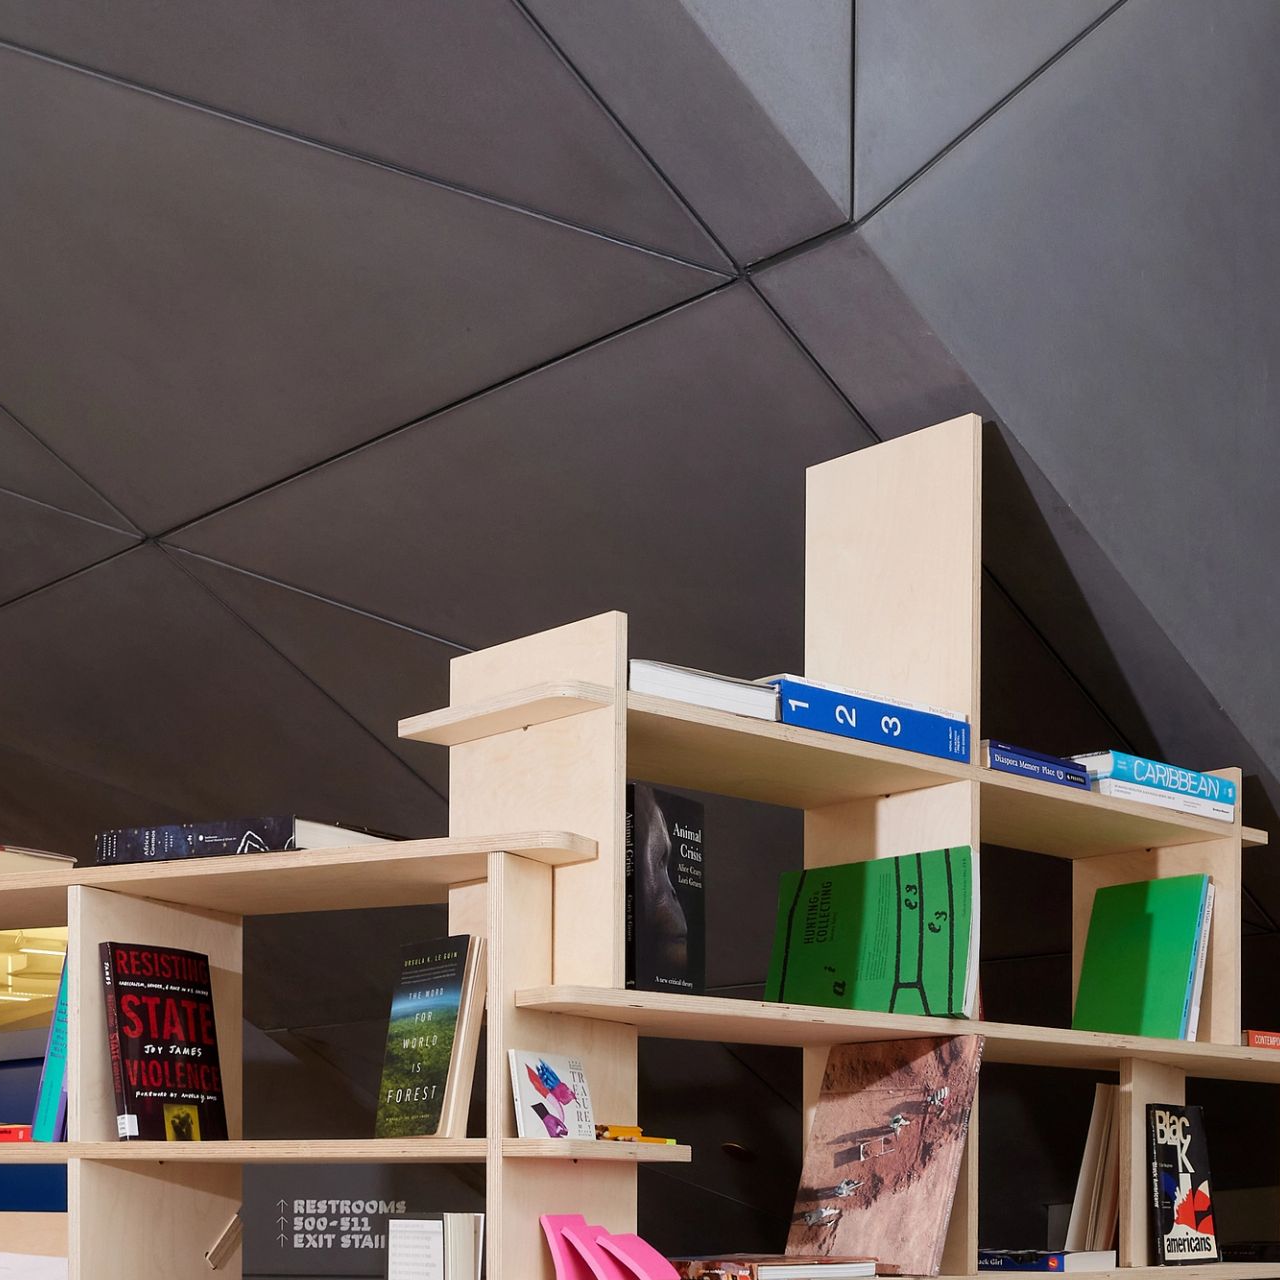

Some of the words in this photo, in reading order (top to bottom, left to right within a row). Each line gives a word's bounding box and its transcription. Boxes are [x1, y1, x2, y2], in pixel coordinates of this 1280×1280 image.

[788, 699, 809, 711] 1
[835, 704, 856, 728] 2
[881, 715, 901, 737] 3
[994, 753, 1018, 769] Diaspora
[1019, 759, 1040, 774] Memory
[1042, 764, 1055, 777] Place
[1133, 760, 1220, 799] CARIBBEAN
[672, 822, 702, 844] Animal
[680, 843, 702, 862] Crisis
[816, 881, 833, 944] COLLECTING
[115, 950, 209, 984] RESISTING
[409, 991, 421, 1000] THE
[425, 987, 444, 998] WORD
[120, 993, 214, 1045] STATE
[414, 1011, 432, 1023] FOR
[144, 1044, 163, 1054] JOY
[168, 1045, 202, 1057] JAMES
[402, 1034, 438, 1049] WORLD
[125, 1058, 220, 1092] VIOLENCE
[411, 1063, 421, 1073] IS
[386, 1085, 437, 1104] FOREST
[293, 1200, 407, 1214] RESTROOMS
[293, 1217, 371, 1231] 500-511
[293, 1234, 336, 1249] EXIT
[1166, 1232, 1212, 1254] americans
